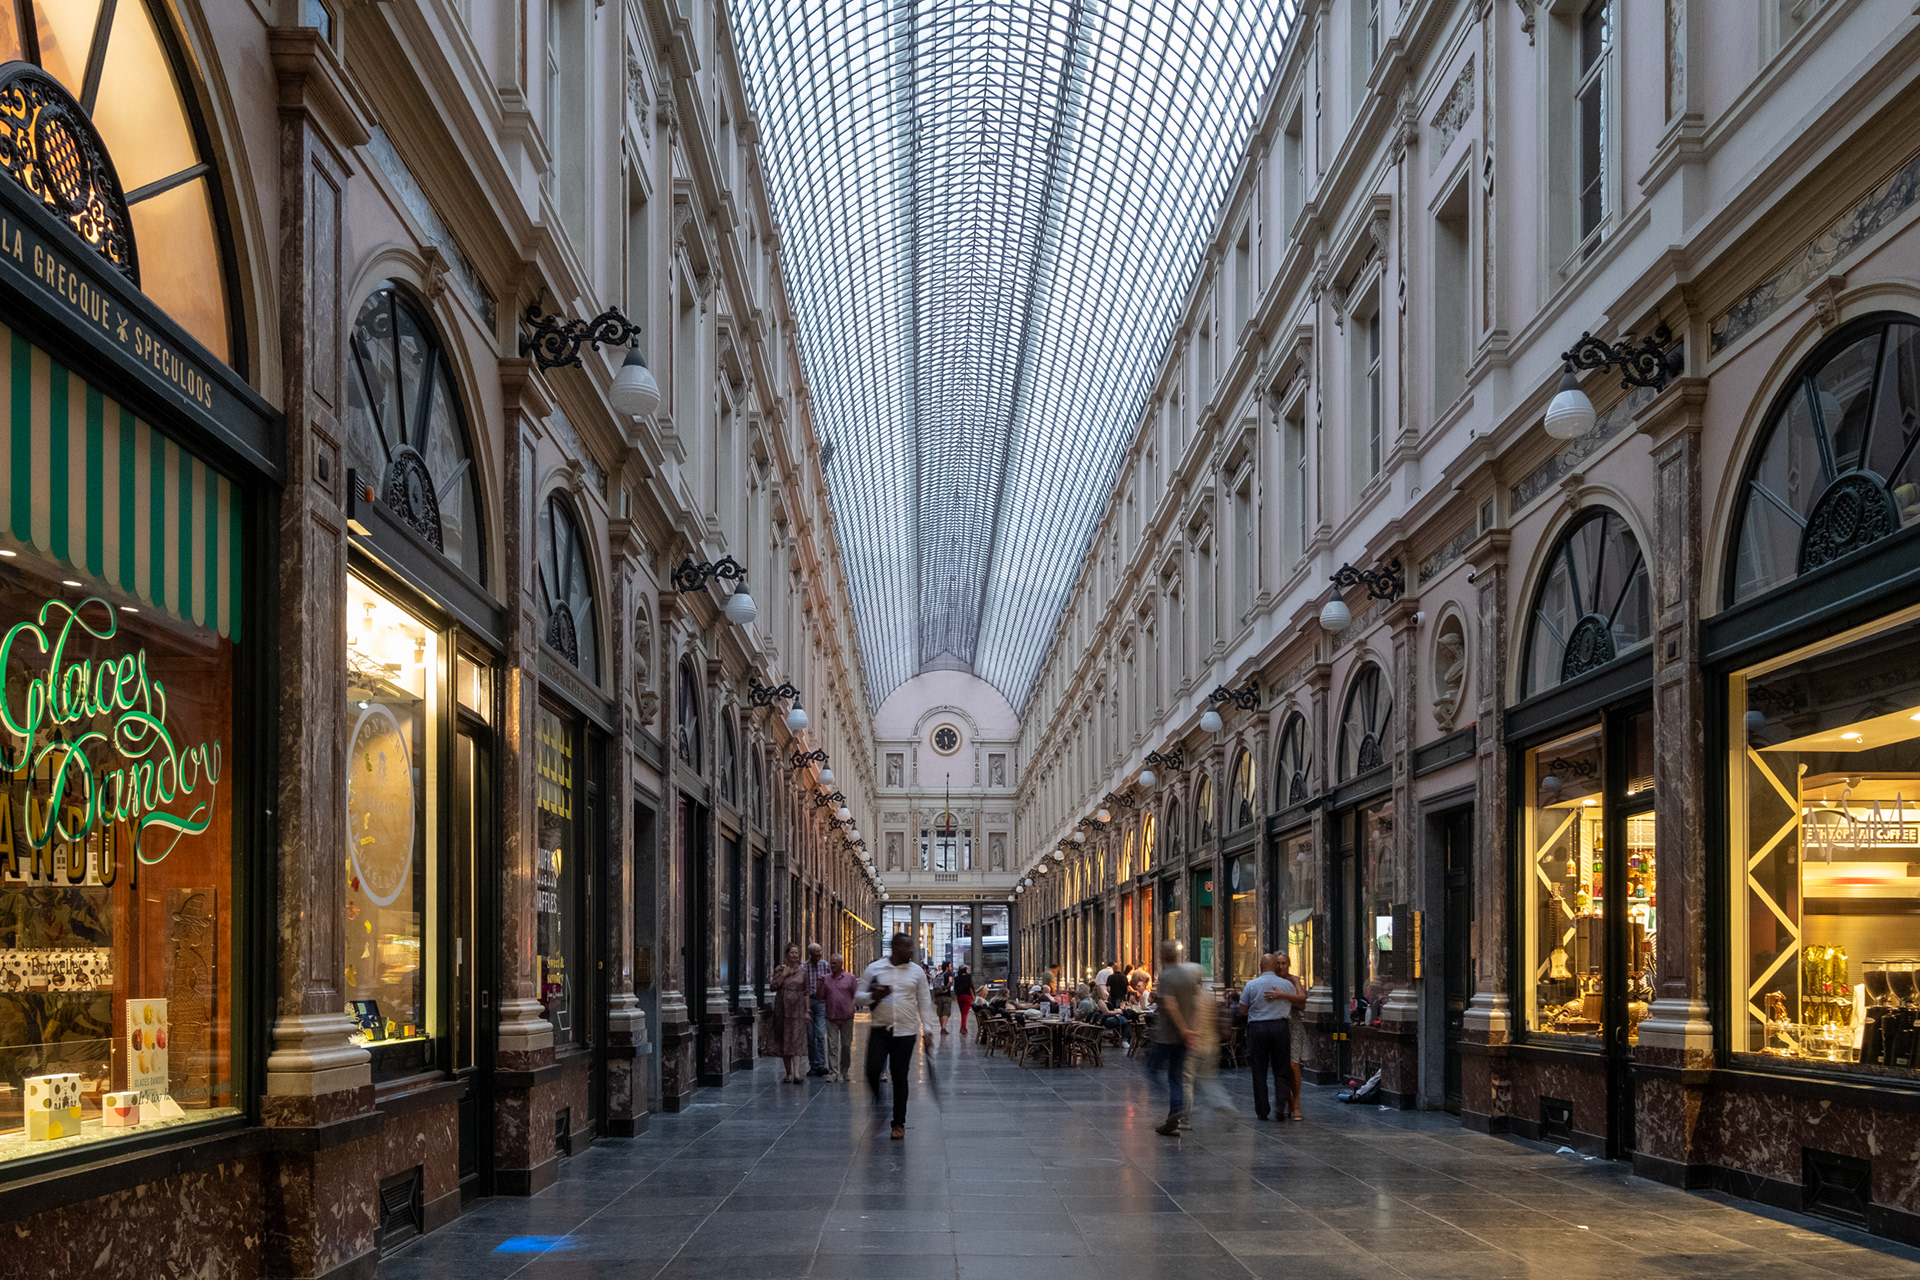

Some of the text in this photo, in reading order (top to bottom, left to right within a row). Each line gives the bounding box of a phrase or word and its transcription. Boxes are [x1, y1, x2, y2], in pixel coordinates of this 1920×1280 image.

[1, 217, 213, 409] LA GRECQUE SPECULOOS
[0, 596, 154, 772] Glaces
[26, 681, 221, 865] Dandoy
[0, 792, 142, 890] ANDOY
[1806, 828, 1874, 840] ETHIOPIAN
[1876, 828, 1917, 840] COFFEE
[31, 957, 84, 976] Bruxelles
[134, 1076, 165, 1088] GLACES DANDOY
